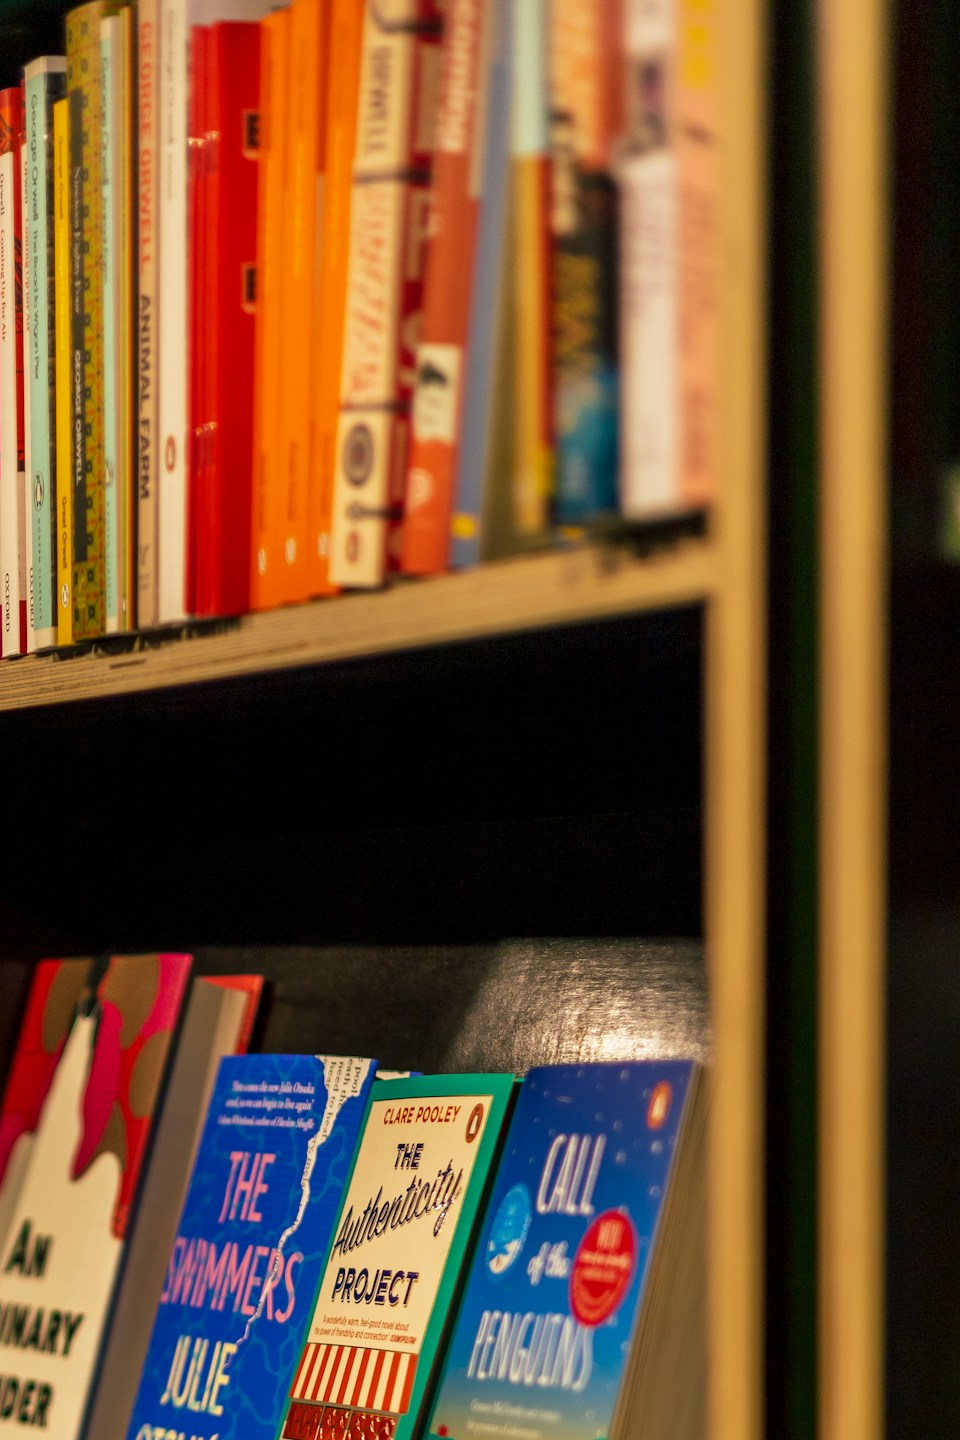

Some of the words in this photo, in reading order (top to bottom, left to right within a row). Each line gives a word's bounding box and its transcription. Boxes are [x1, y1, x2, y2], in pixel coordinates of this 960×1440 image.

[140, 21, 152, 138] GEORGE
[30, 94, 39, 162] George
[31, 166, 40, 221] Orwell
[140, 148, 152, 274] ORWELL
[0, 281, 7, 299] Up
[33, 296, 39, 309] to
[32, 311, 40, 354] Wigan
[140, 293, 151, 412] ANIMAL
[75, 350, 83, 415] GEORGE
[140, 418, 151, 501] FARM
[350, 1066, 363, 1096] pool
[383, 1106, 415, 1126] CLARE
[415, 1105, 462, 1124] POOLEY
[218, 1150, 277, 1224] THE
[393, 1142, 425, 1171] THE
[535, 1131, 608, 1217] CALL
[330, 1157, 465, 1263] Authenticity
[160, 1236, 305, 1324] SWIMMERS
[331, 1266, 420, 1309] PROJECT
[527, 1240, 551, 1287] of
[544, 1239, 571, 1280] the
[159, 1334, 238, 1418] JULIE
[465, 1309, 595, 1394] PENGUINS
